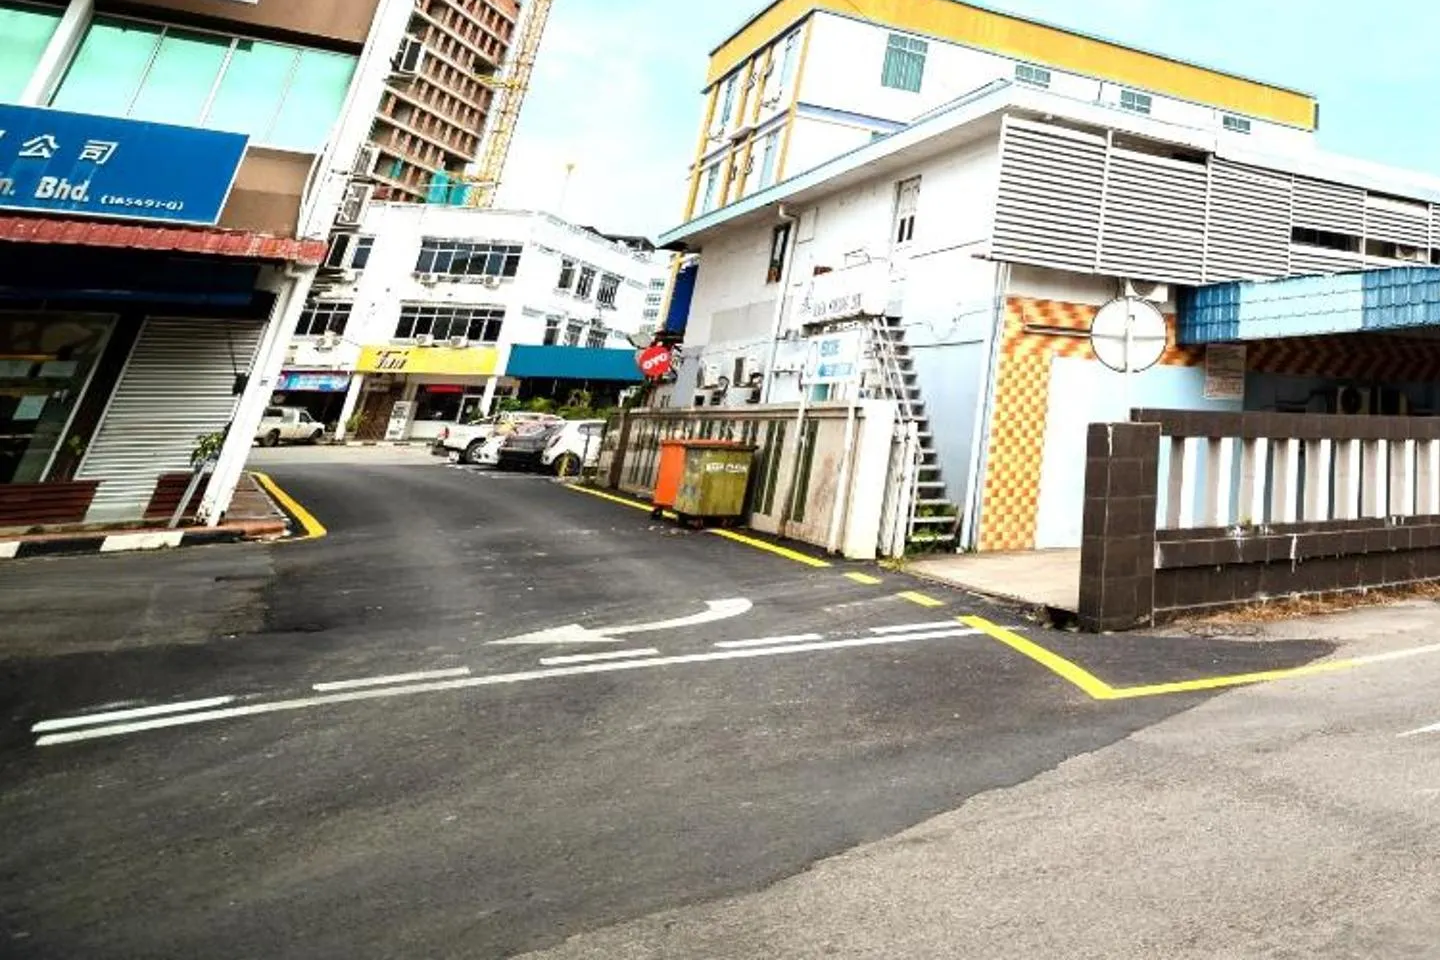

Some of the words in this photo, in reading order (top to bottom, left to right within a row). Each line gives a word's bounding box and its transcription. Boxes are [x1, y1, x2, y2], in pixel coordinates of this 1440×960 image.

[0, 129, 119, 165] 公司
[34, 176, 89, 202] Bhd.
[642, 352, 668, 370] OYO
